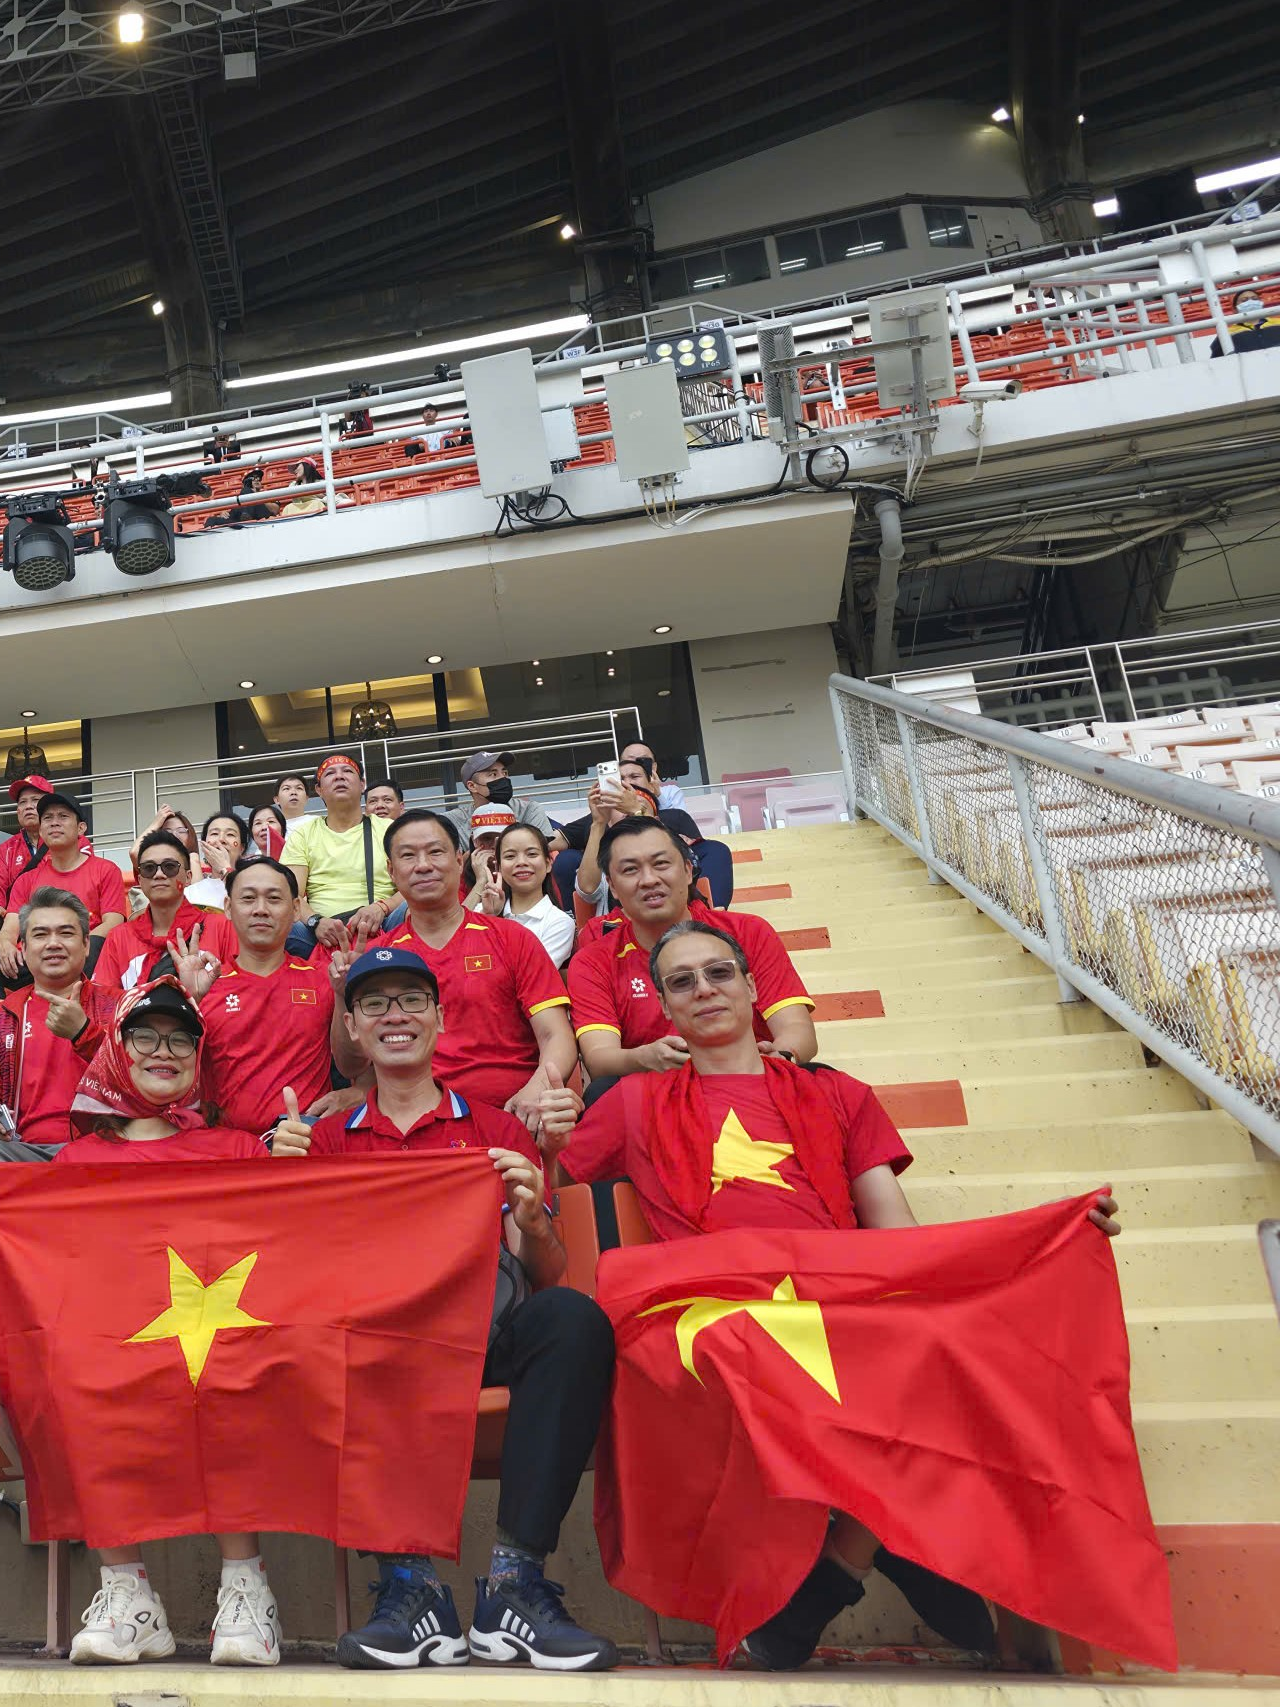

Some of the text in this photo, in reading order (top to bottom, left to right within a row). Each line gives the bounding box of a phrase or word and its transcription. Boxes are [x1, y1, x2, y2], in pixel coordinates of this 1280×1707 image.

[701, 360, 721, 369] IP65
[1215, 722, 1225, 731] 11
[1060, 729, 1070, 738] 10
[1096, 737, 1106, 746] 10
[1138, 753, 1149, 763] 10
[1189, 770, 1202, 780] 10
[1261, 786, 1275, 797] 10
